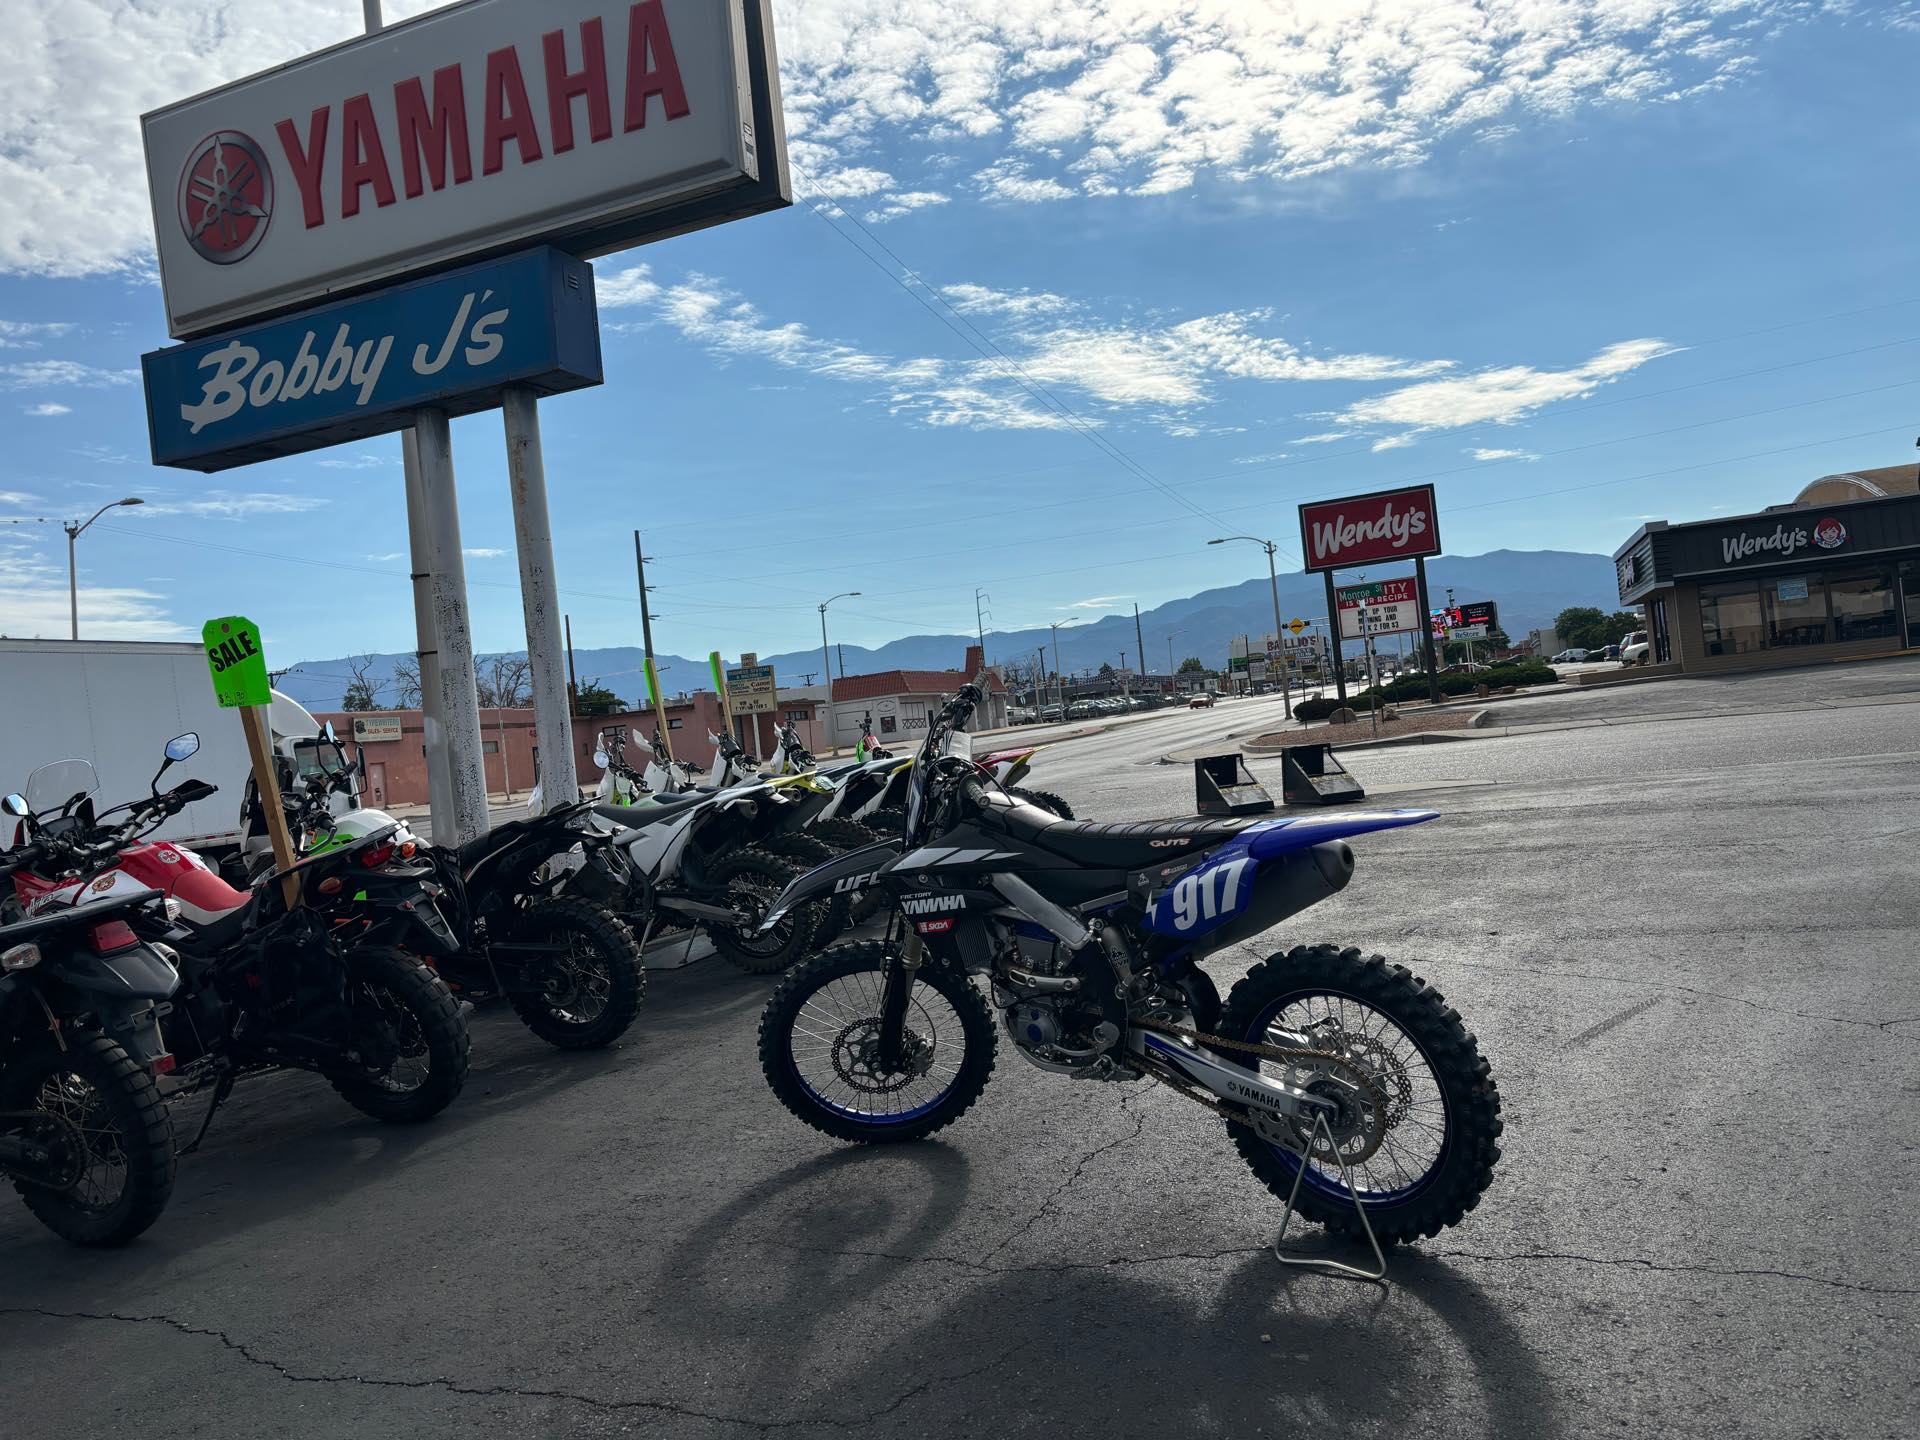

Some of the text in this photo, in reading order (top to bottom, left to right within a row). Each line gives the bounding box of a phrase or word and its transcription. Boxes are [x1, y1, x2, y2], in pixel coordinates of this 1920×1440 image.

[275, 0, 689, 229] YAMAHA
[181, 289, 509, 434] Bobby J's
[1312, 503, 1426, 560] Wendy's
[1722, 525, 1807, 563] Wendy's
[1339, 589, 1370, 602] Monroe
[1357, 597, 1375, 605] UR
[1377, 592, 1408, 603] RECIPE
[1372, 607, 1380, 615] UP
[1383, 605, 1398, 613] YOUR
[1386, 613, 1397, 621] AND
[1359, 625, 1372, 633] PK
[1379, 622, 1390, 630] FOR
[1391, 621, 1399, 629] $3
[1455, 631, 1480, 639] ReStore
[208, 630, 258, 673] SALE
[1149, 838, 1191, 848] GUTS
[901, 894, 966, 915] YAMAHA
[1173, 857, 1249, 931] 917
[1238, 1084, 1281, 1110] YAMAHA
